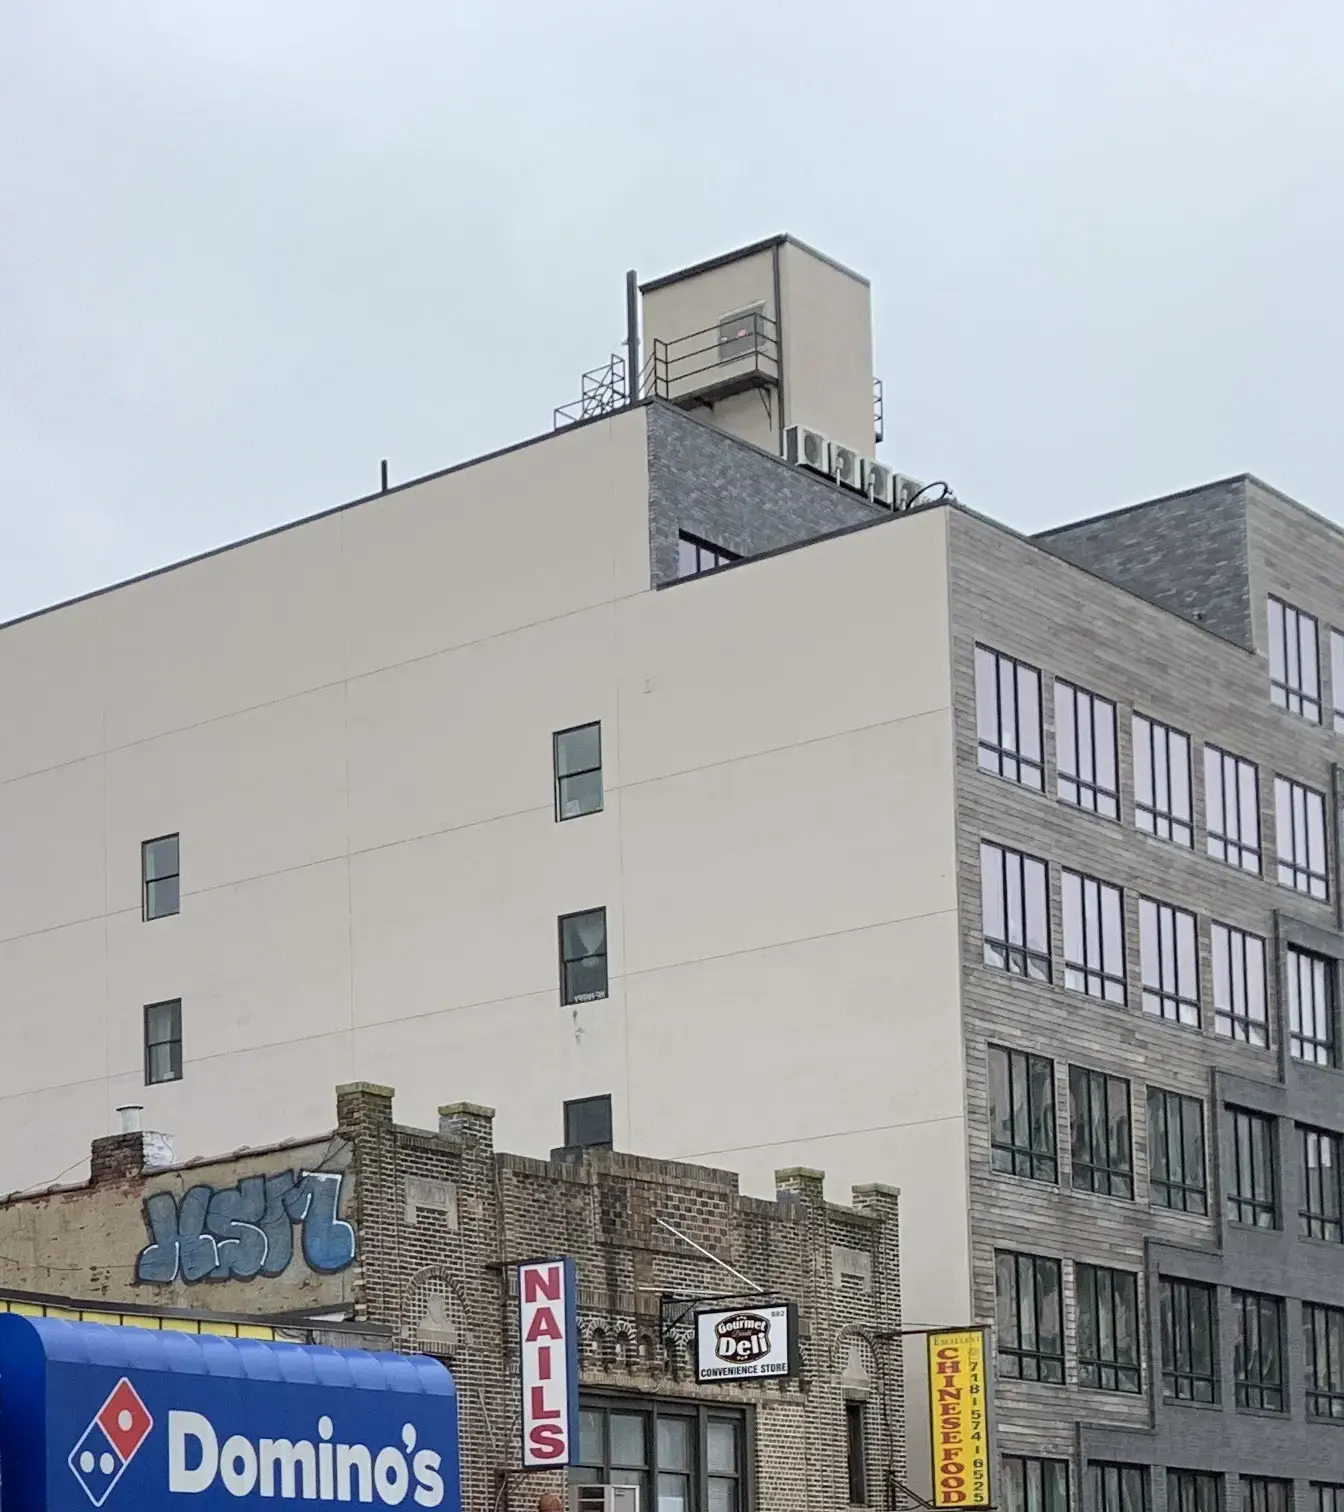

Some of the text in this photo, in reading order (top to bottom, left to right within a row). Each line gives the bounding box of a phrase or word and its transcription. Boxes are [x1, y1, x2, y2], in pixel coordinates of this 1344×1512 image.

[718, 1319, 767, 1334] Gourmet
[718, 1332, 768, 1356] Deli
[523, 1266, 566, 1461] NAILS
[700, 1362, 787, 1378] CONVENIENCE STORE
[935, 1347, 967, 1503] CHINESE FOOD
[167, 1409, 445, 1509] Domino's
